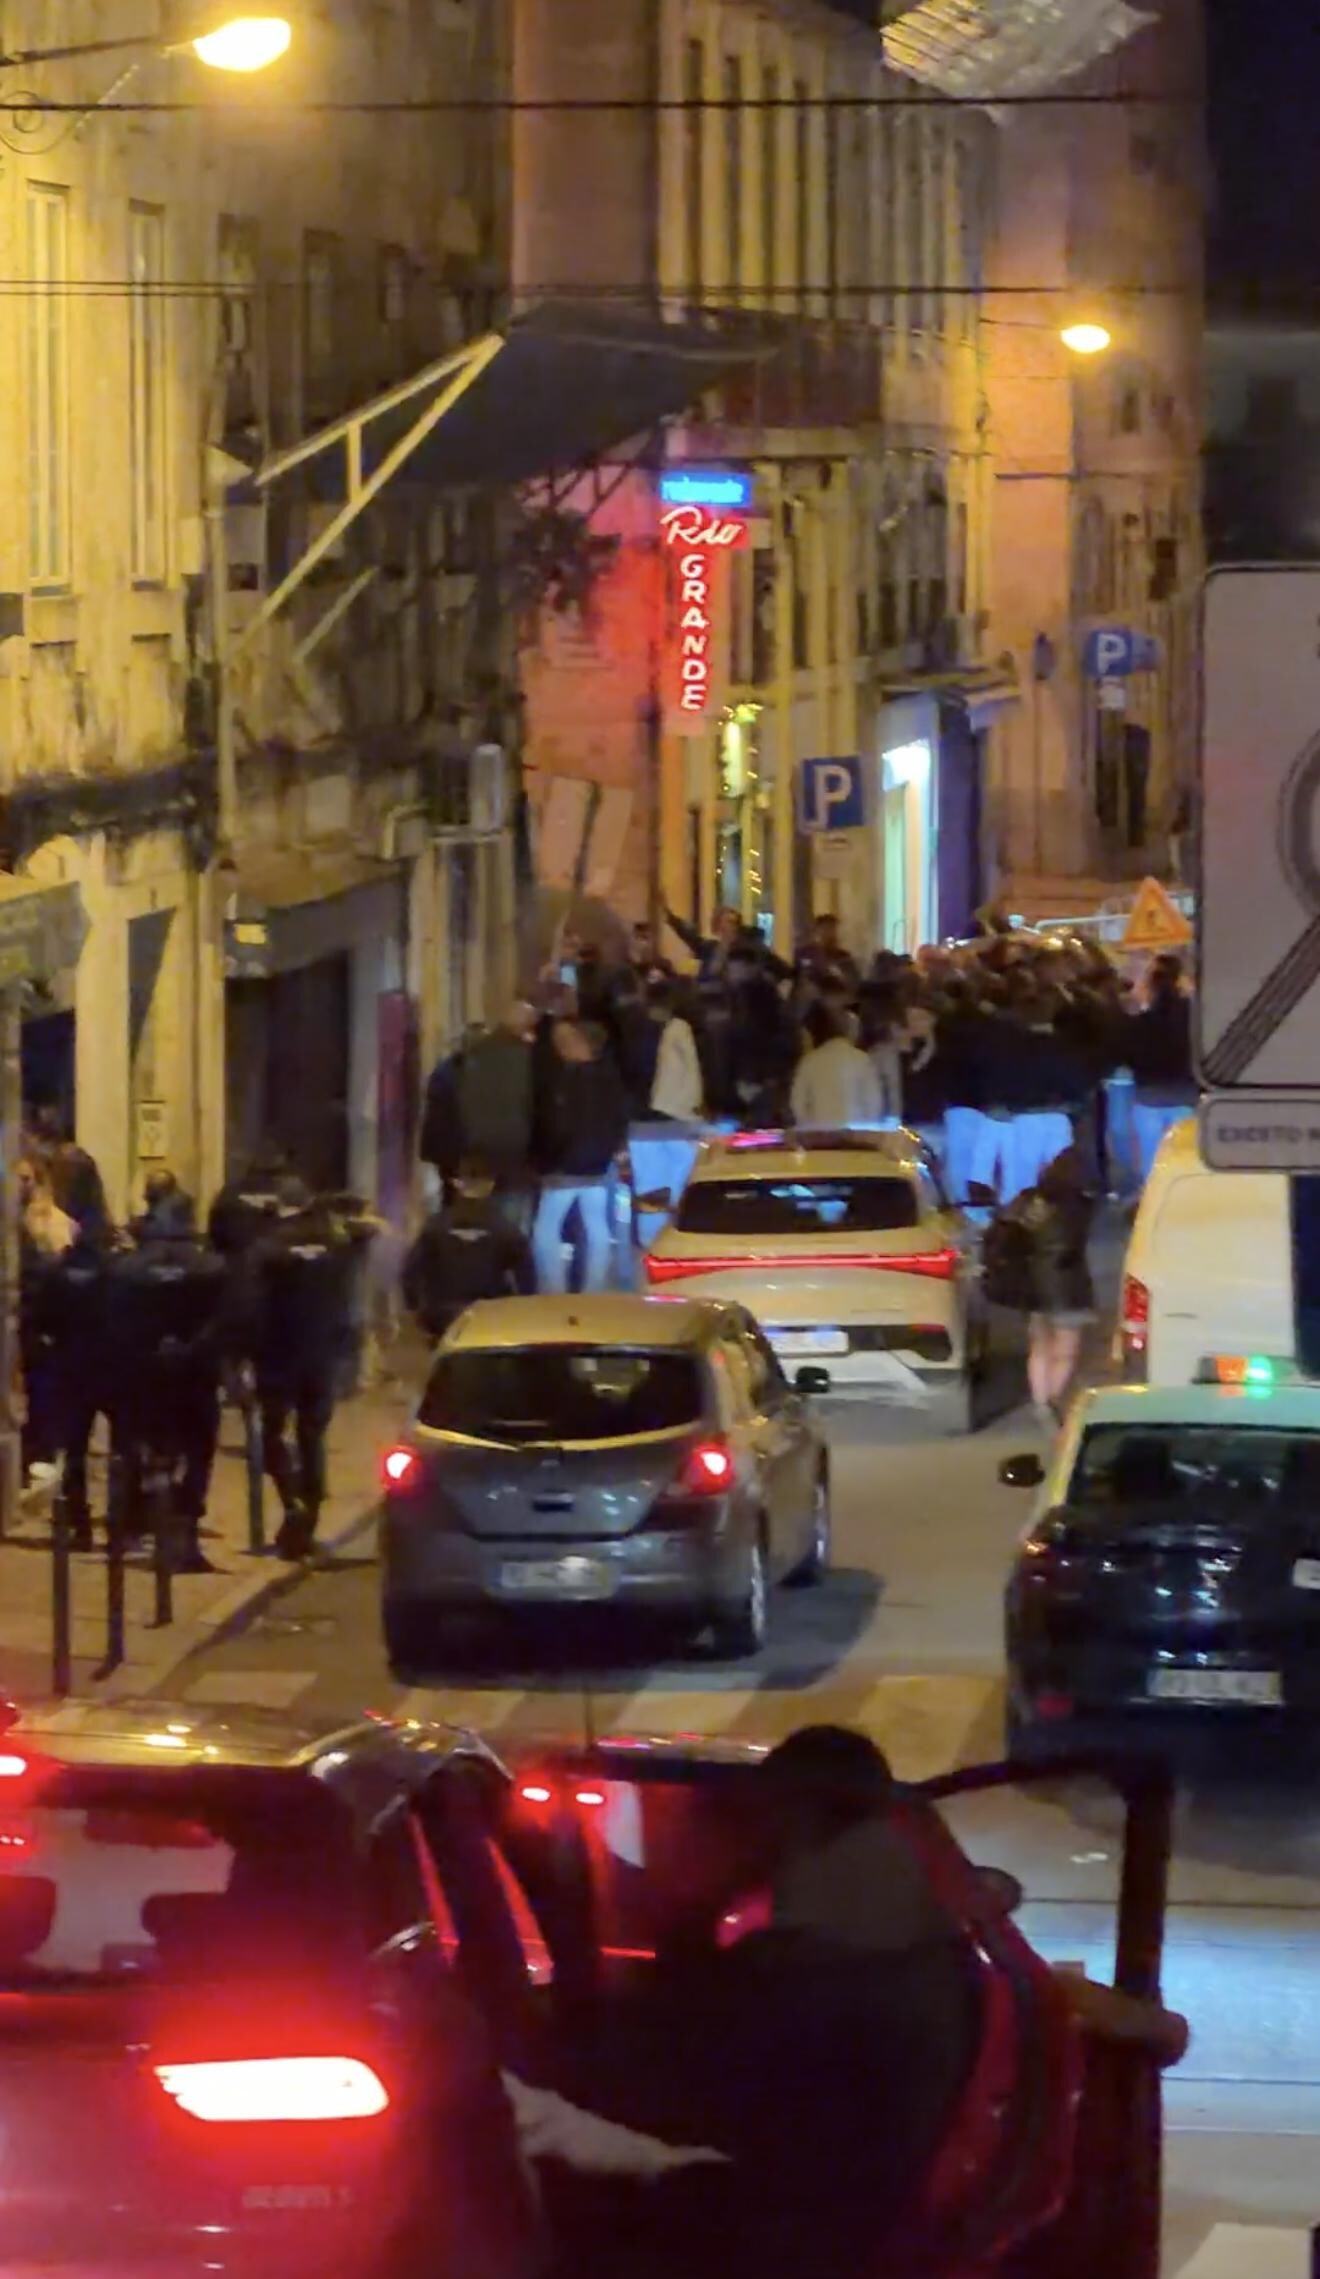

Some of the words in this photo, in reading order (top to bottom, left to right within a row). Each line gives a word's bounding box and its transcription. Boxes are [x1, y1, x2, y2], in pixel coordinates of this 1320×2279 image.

[660, 506, 743, 544] Rio
[680, 554, 709, 710] GRANDE
[1097, 633, 1127, 674] P
[814, 765, 852, 830] P
